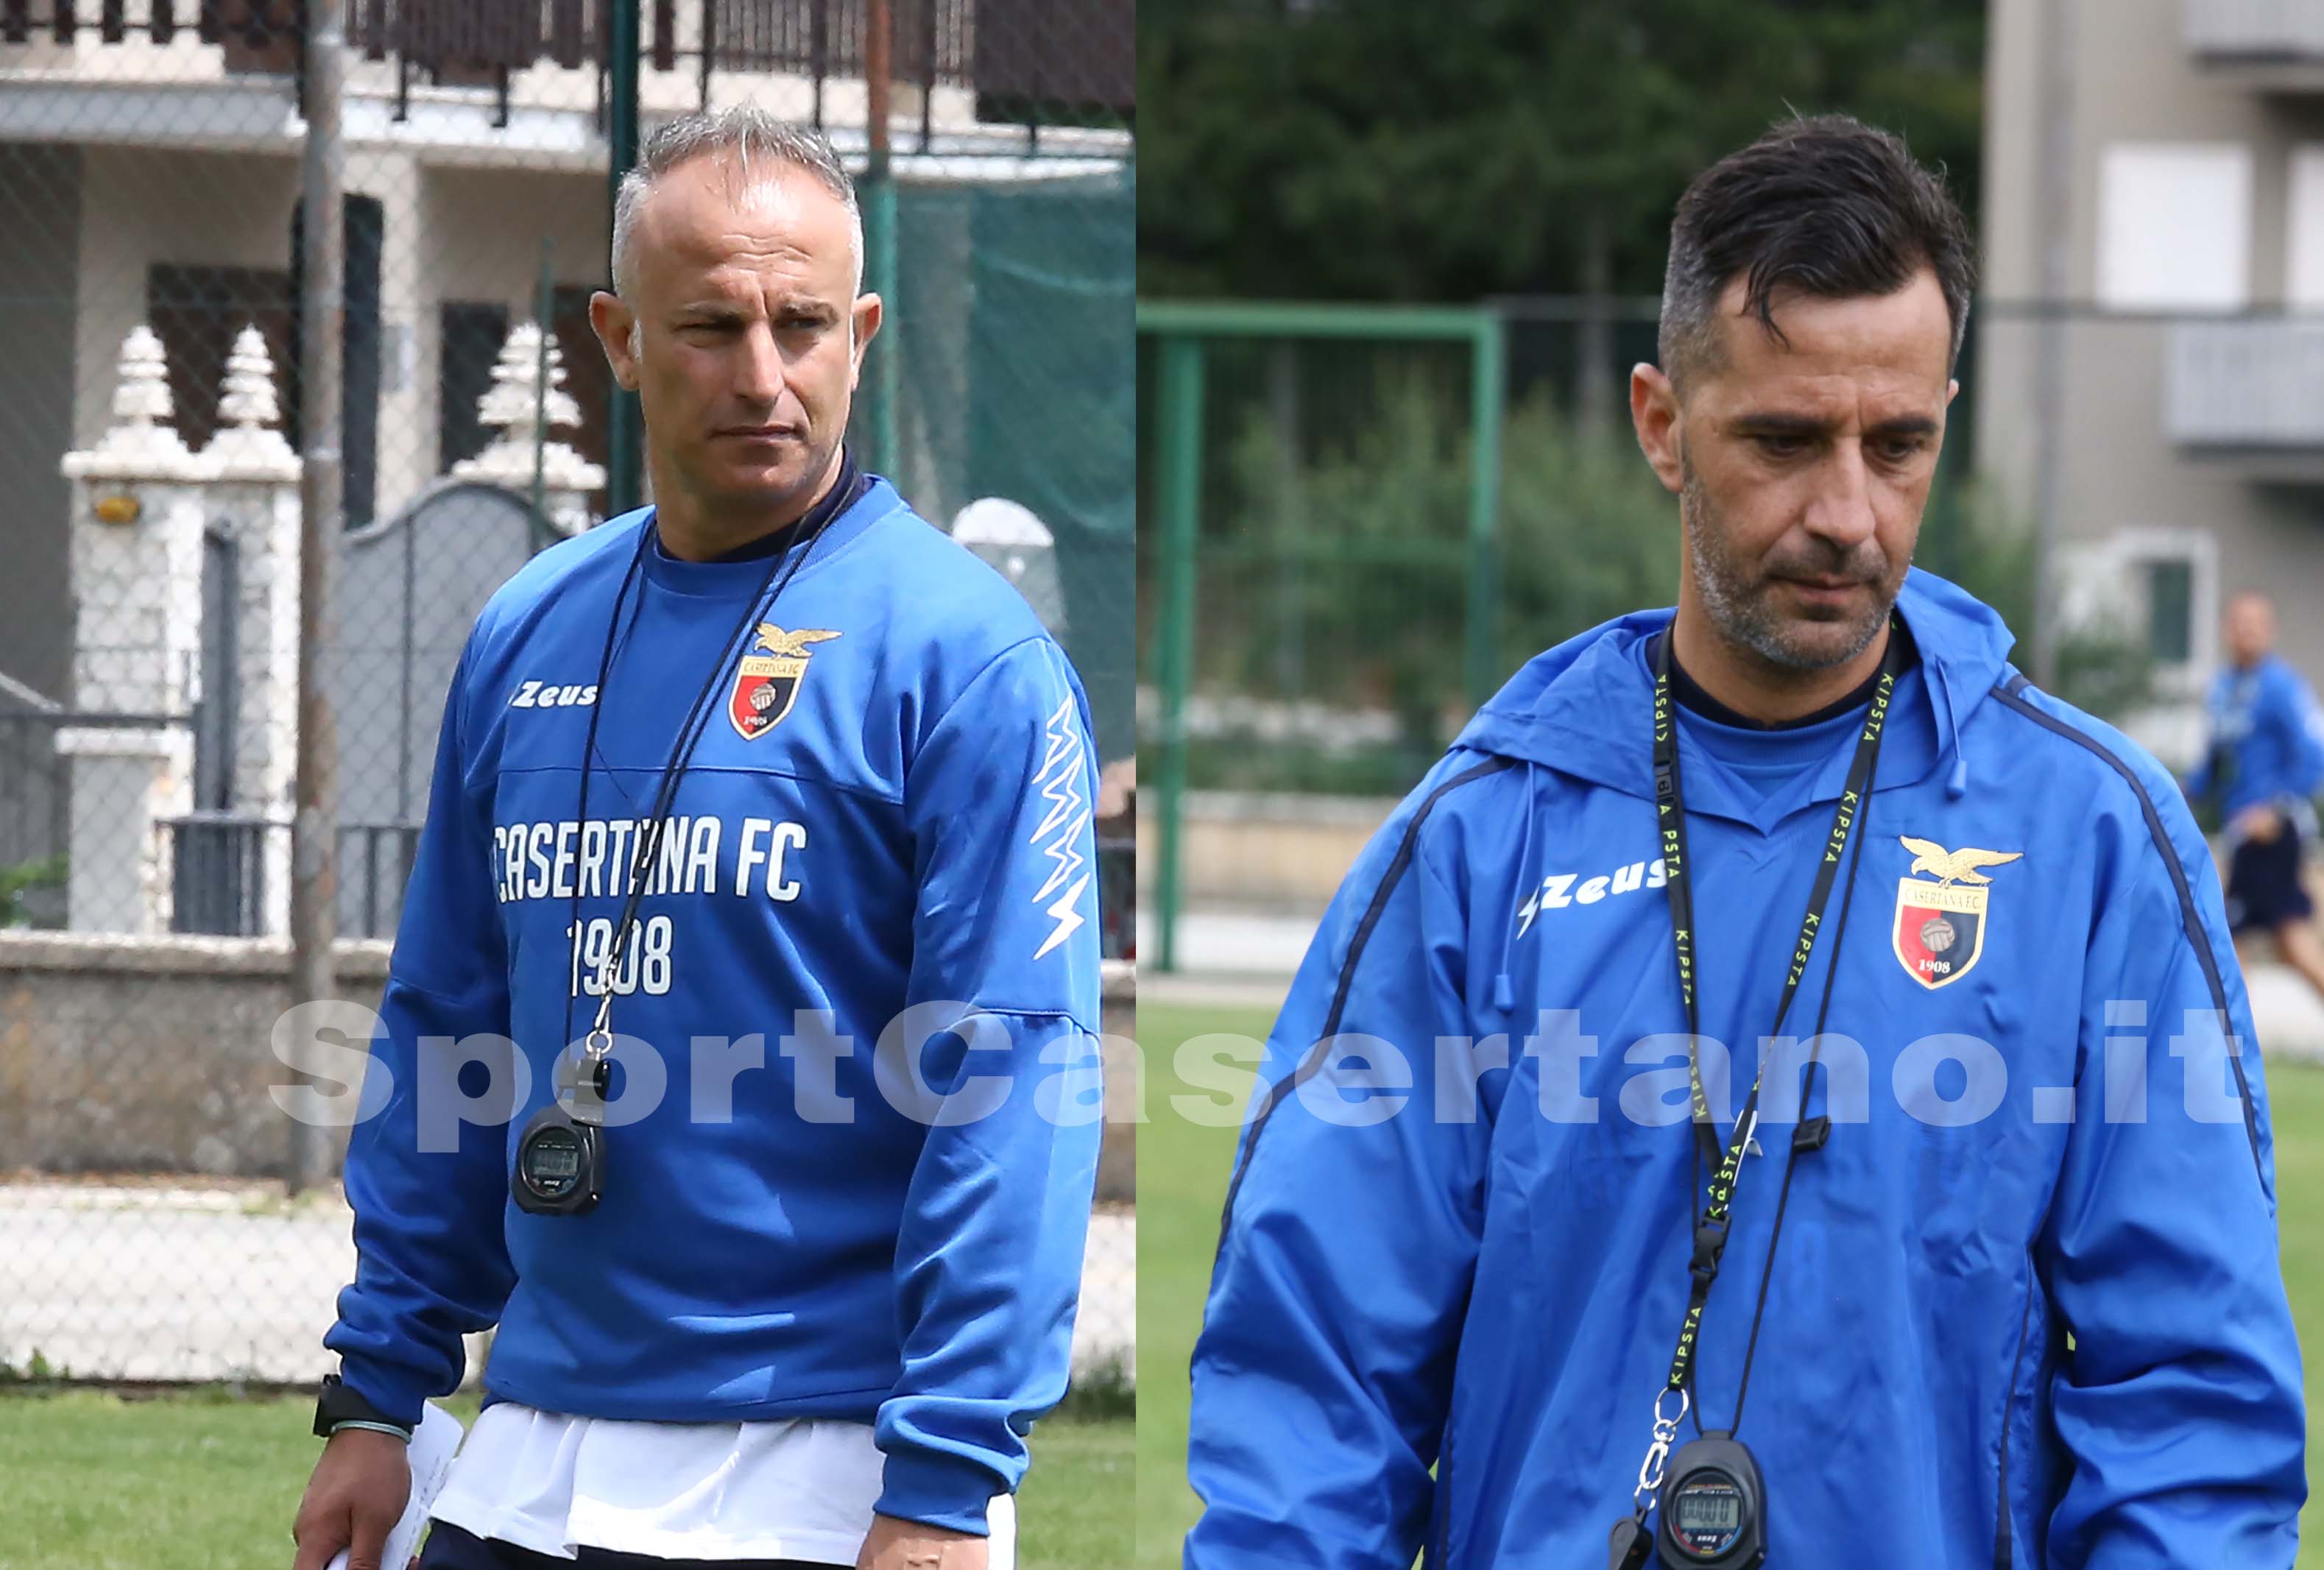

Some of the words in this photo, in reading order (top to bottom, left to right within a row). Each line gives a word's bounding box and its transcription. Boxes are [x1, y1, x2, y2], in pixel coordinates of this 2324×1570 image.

[512, 680, 598, 707] Zeus
[1862, 672, 1895, 742] KIPSTA
[735, 817, 808, 902] FC
[1825, 790, 1859, 863] KIPSTA
[1540, 858, 1668, 910] Zeus
[566, 915, 673, 997] 1908
[1787, 913, 1820, 986] KIPSTA
[1918, 959, 1951, 974] 1908
[1671, 1306, 1701, 1385] KIPSTA
